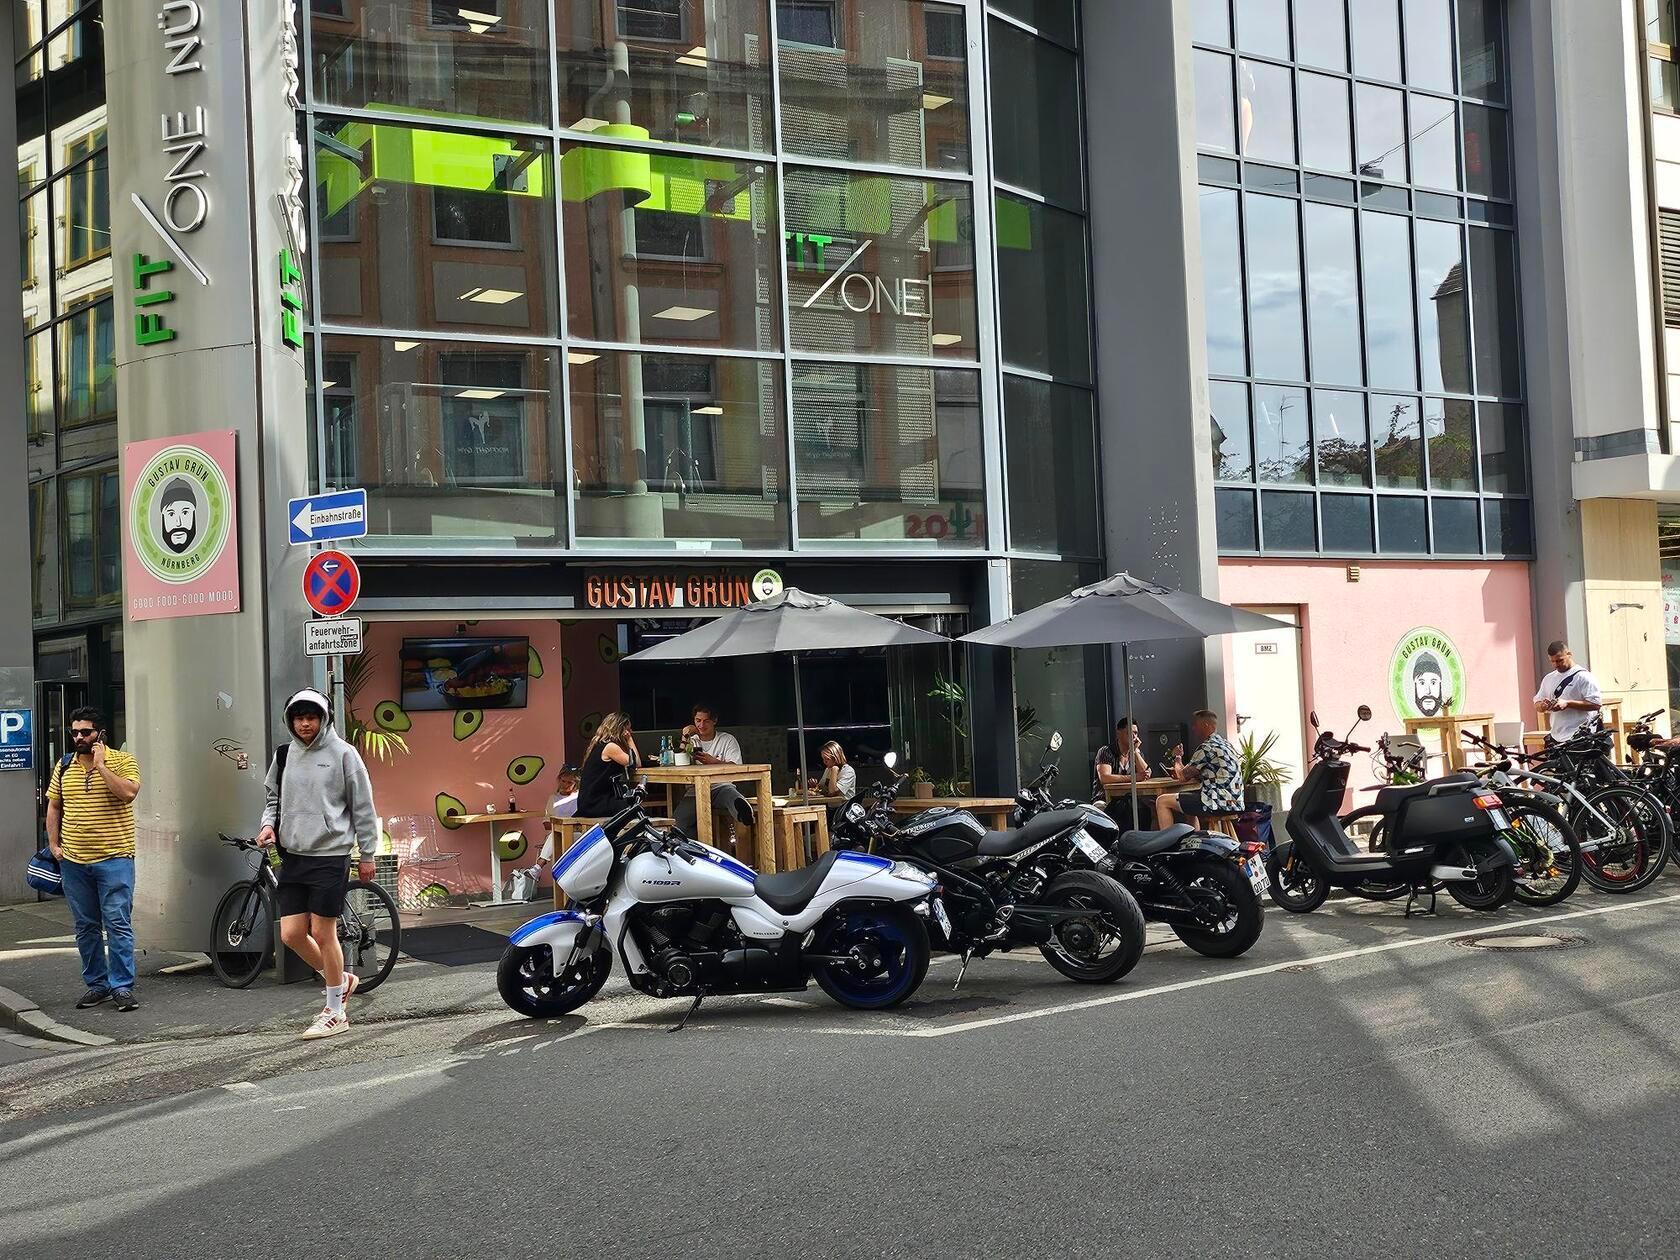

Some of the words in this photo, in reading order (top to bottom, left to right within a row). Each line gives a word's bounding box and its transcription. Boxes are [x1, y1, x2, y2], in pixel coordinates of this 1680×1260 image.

[134, 253, 175, 346] FIT
[147, 458, 180, 488] GUSTAV
[184, 459, 209, 482] GRÜN
[310, 509, 362, 524] Einbahnstraße
[161, 553, 200, 570] NÜRNBERG
[208, 590, 234, 602] MOOD
[586, 574, 677, 608] GUSTAV
[686, 567, 750, 608] GRÜN
[310, 624, 354, 637] Feuerwehr-
[309, 638, 358, 650] anfahrtszone
[1402, 636, 1429, 659] GUSTAV
[1431, 637, 1452, 658] GRÜN
[1, 713, 25, 744] P
[641, 879, 682, 887] M109R
